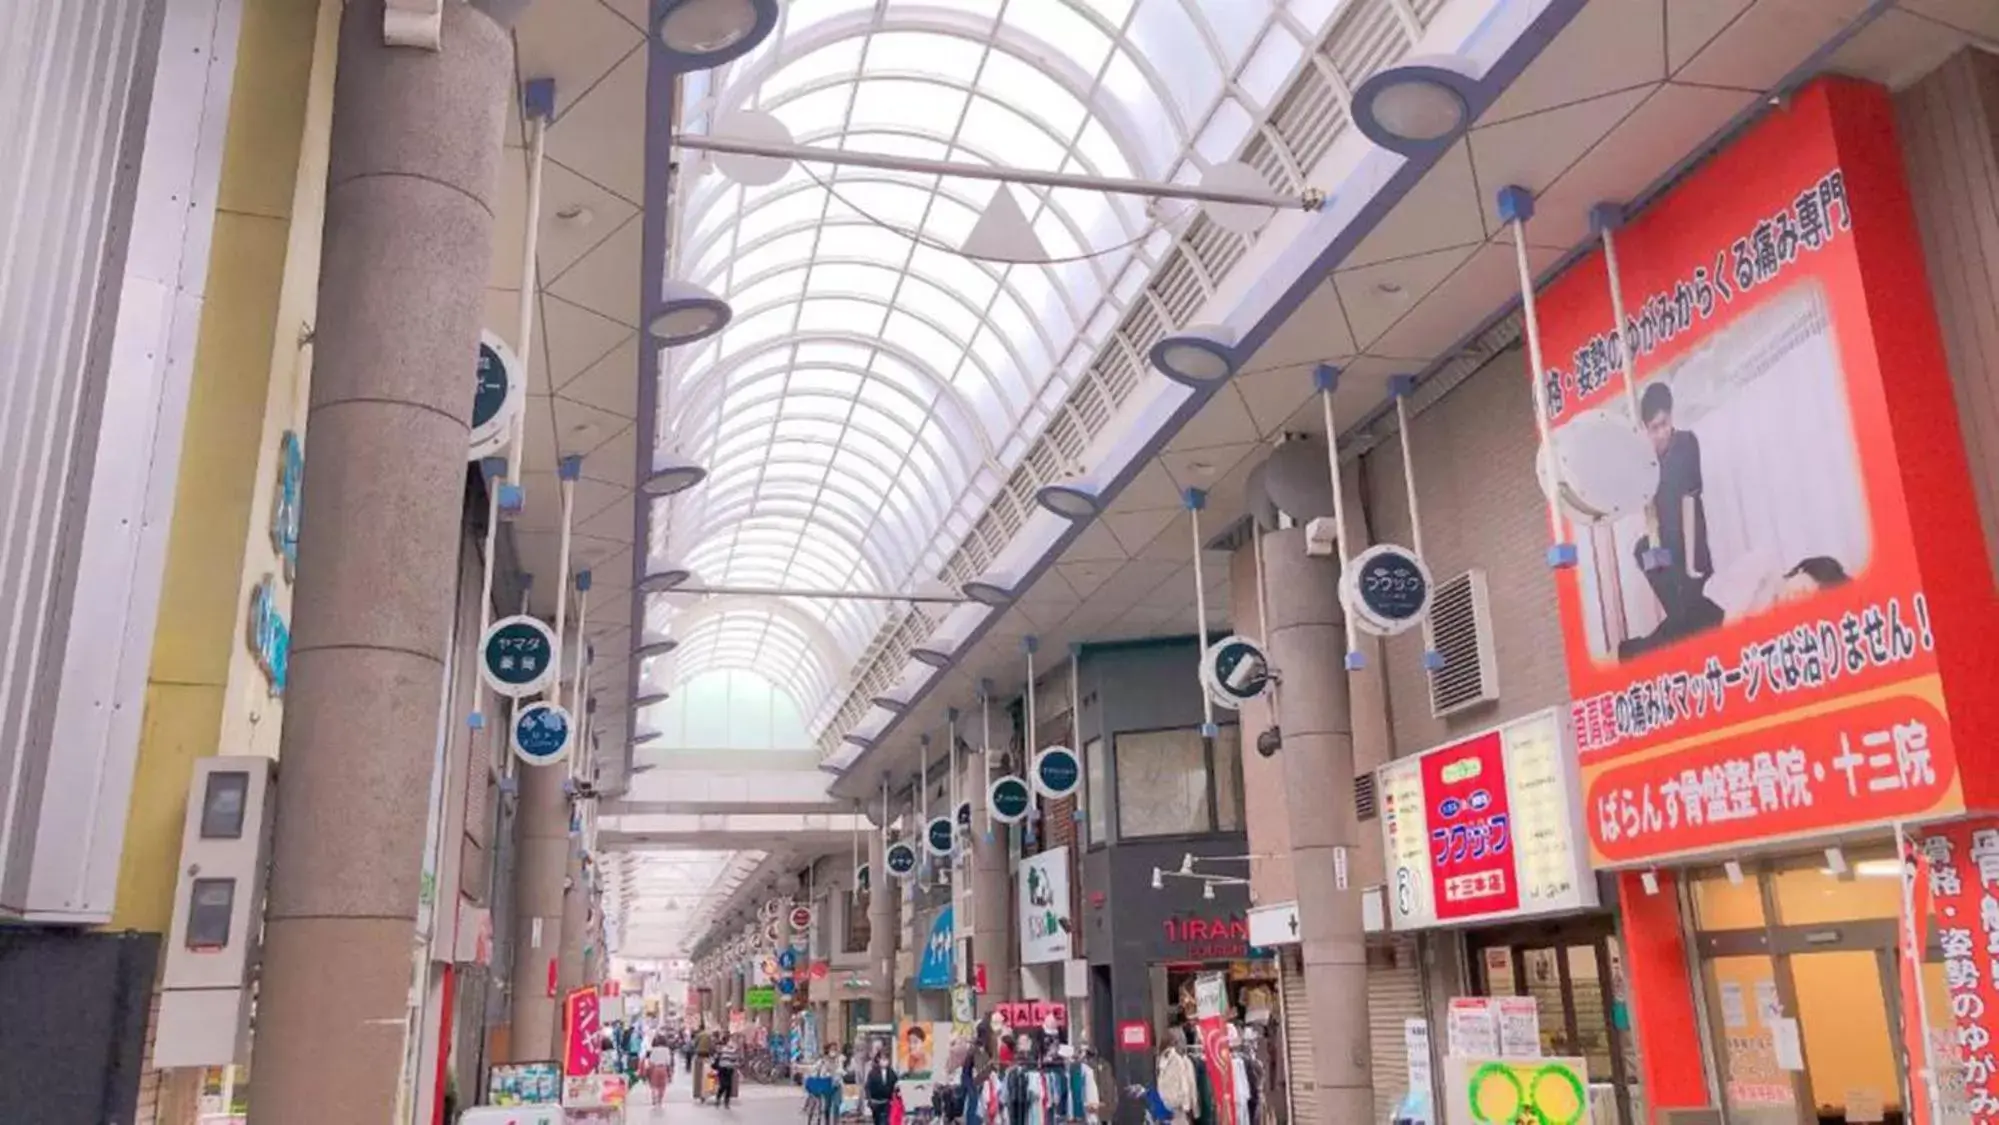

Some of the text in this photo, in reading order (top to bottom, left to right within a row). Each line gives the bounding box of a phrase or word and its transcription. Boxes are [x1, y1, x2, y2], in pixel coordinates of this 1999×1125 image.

[1538, 167, 1851, 418] 格・姿勢のゆがみからくる痛み専門
[1597, 719, 1936, 841] ばらんす骨盤整骨院・十三院
[1924, 835, 1999, 1125] 骨格・姿勢のゆがみ
